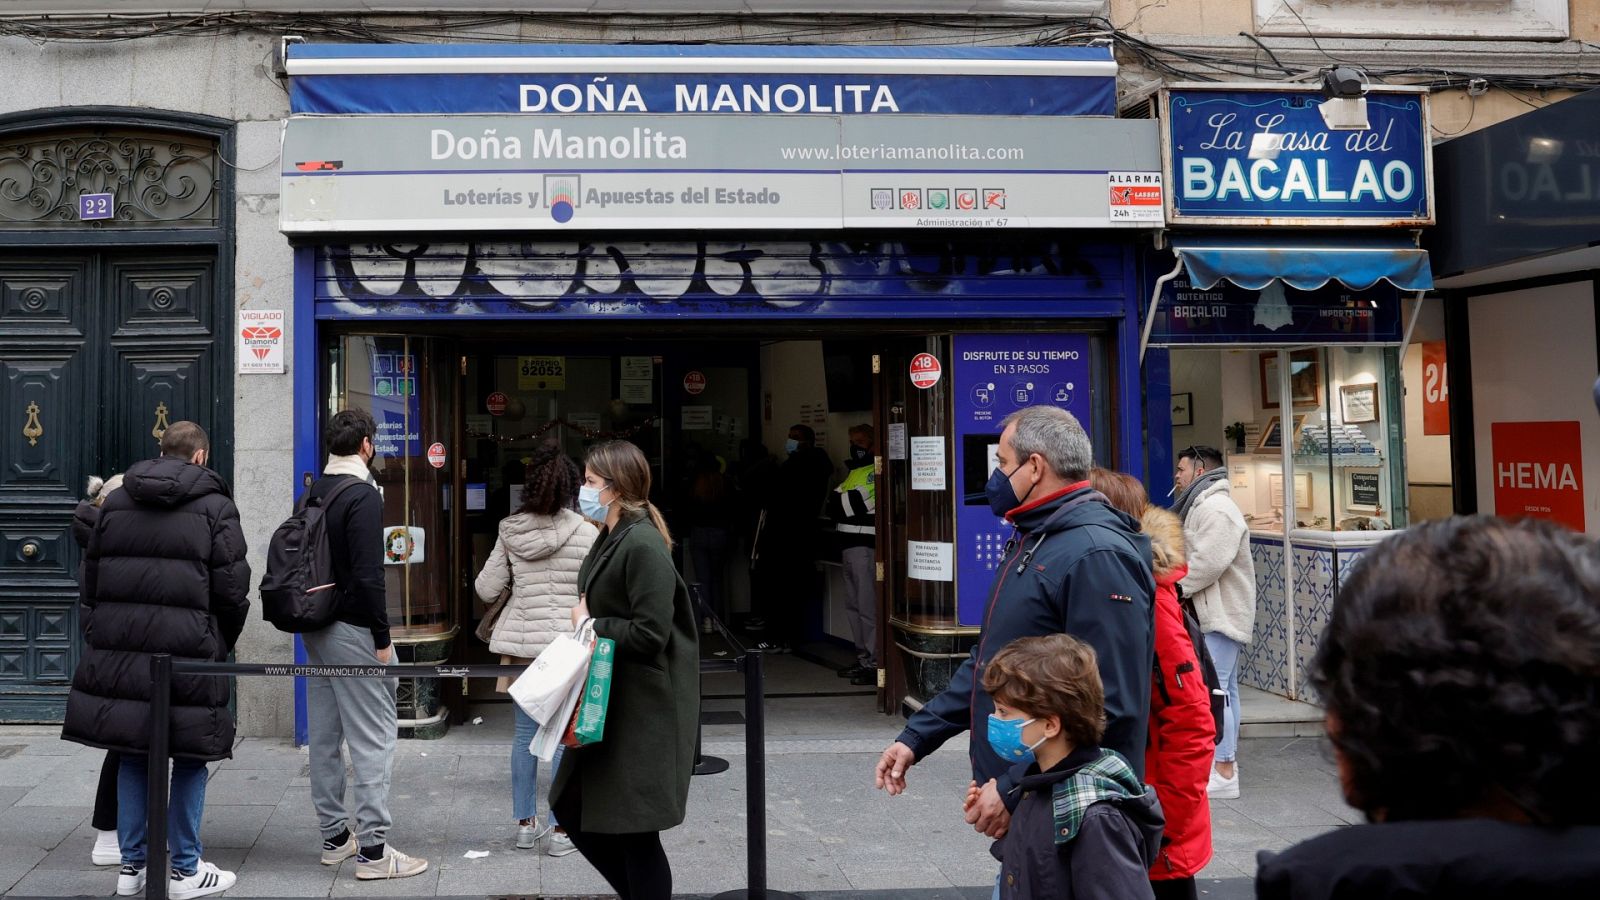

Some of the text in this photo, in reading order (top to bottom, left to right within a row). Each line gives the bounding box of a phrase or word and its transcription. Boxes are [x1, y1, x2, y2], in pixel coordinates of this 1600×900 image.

[520, 76, 900, 112] DOÑA MANOLITA
[1200, 113, 1246, 151] La
[1345, 118, 1394, 151] del
[430, 127, 688, 160] Doña Manolita
[780, 144, 1025, 161] www.loteriamanolita.com
[1110, 175, 1161, 183] ALARMA
[1182, 156, 1415, 203] BACALAO
[443, 186, 781, 208] Loterías y Apuestas del Estado
[86, 198, 107, 214] 22
[1114, 209, 1130, 217] 24h
[916, 217, 983, 227] Administración
[996, 217, 1008, 227] 67
[241, 312, 282, 320] VIGILADO
[1174, 306, 1227, 318] BACALAO
[963, 350, 1079, 361] DISFRUTE DE SU TIEMPO
[914, 356, 932, 368] +18
[521, 366, 563, 376] 92052
[994, 365, 1050, 374] EN 3 PASOS
[374, 421, 403, 430] oterías
[375, 444, 399, 452] Estado
[1498, 462, 1579, 490] HEMA
[265, 666, 386, 676] WWW.LOTERIAMANOLITA.COM
